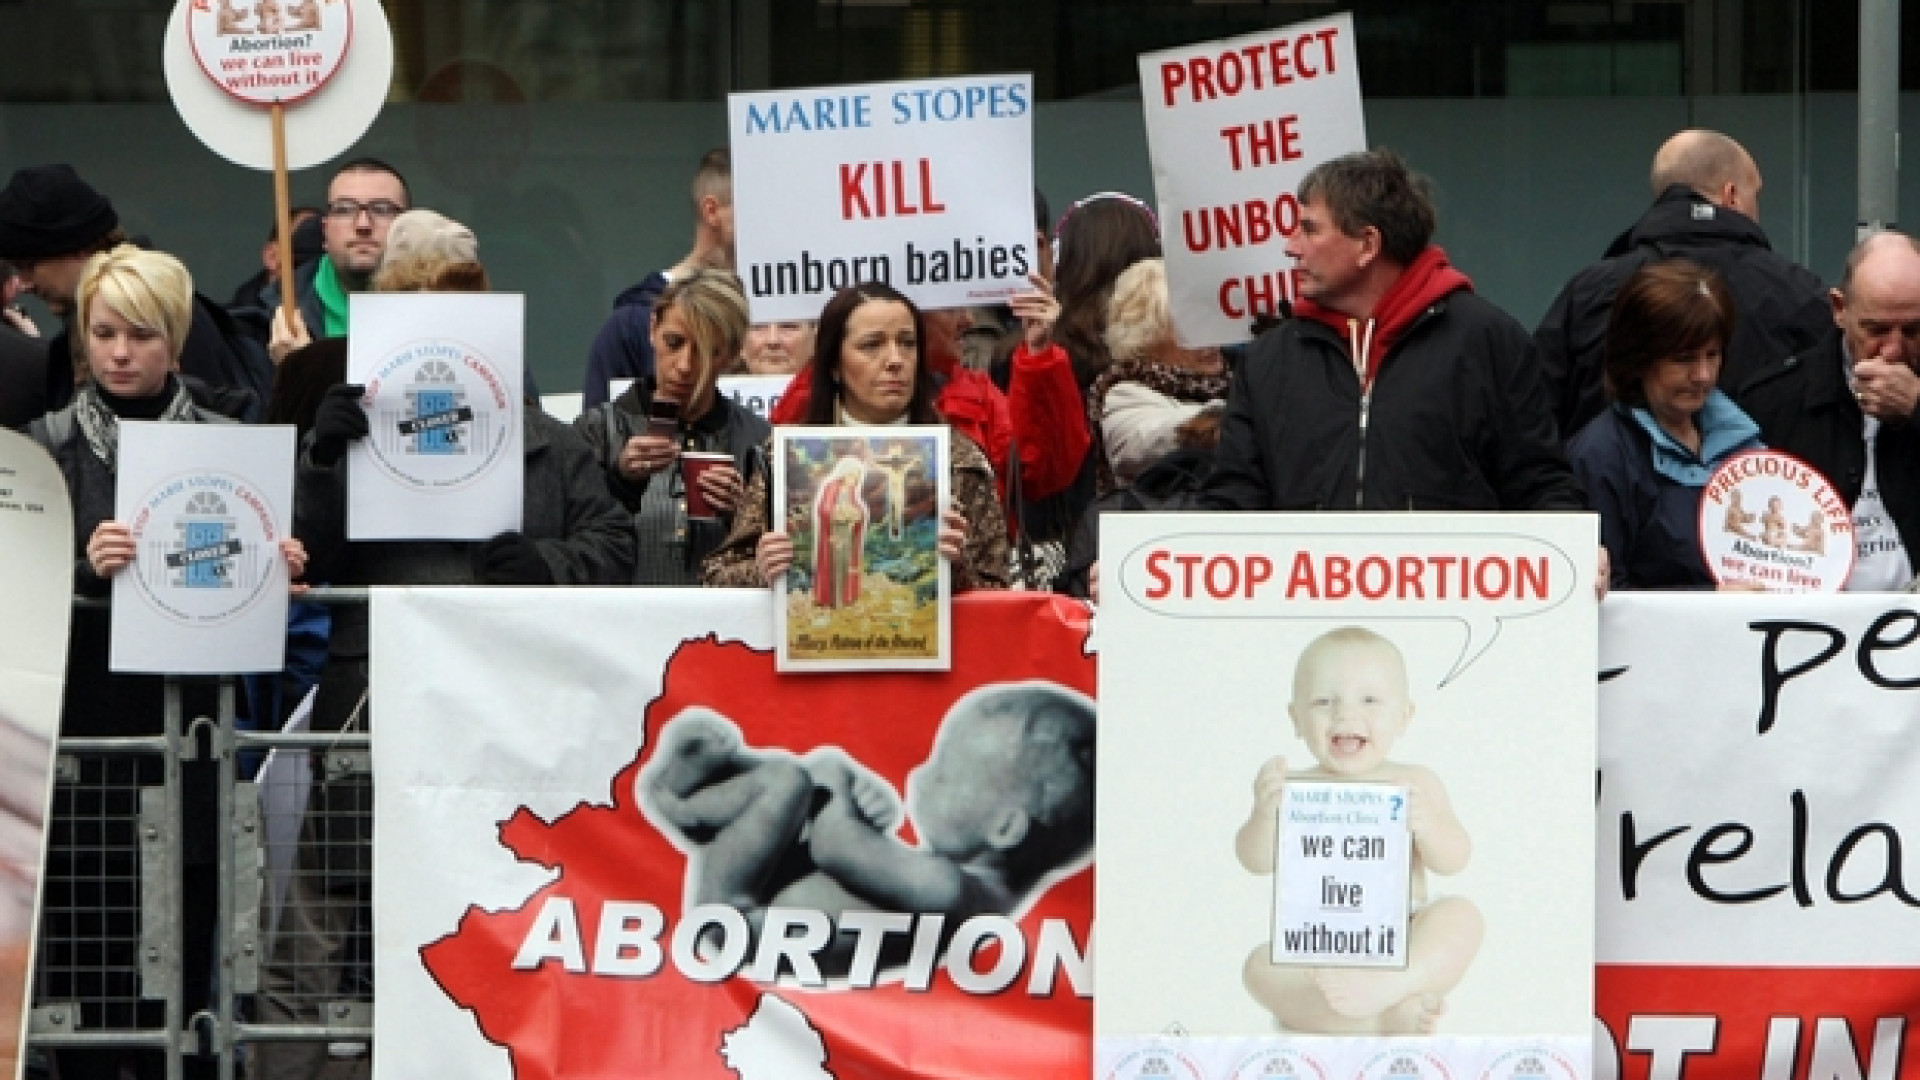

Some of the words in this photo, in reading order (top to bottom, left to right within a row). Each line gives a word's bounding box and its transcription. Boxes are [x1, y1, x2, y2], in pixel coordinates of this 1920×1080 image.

[220, 58, 248, 71] we
[253, 56, 285, 68] can
[290, 52, 322, 66] live
[229, 34, 313, 52] Abortion?
[1160, 27, 1338, 108] PROTECT
[225, 71, 298, 87] without
[306, 70, 320, 84] it
[745, 95, 871, 136] MARIE
[891, 82, 1028, 125] STOPES
[1219, 114, 1304, 171] THE
[839, 157, 946, 220] KILL
[1182, 192, 1299, 253] UNBO
[750, 251, 890, 298] unborn
[906, 235, 1029, 285] babies
[1217, 269, 1301, 320] CHI
[1709, 457, 1810, 504] PRECIOUS
[1812, 486, 1853, 533] LIFE
[1144, 549, 1274, 601] STOP
[1284, 550, 1550, 601] ABORTION
[1722, 556, 1744, 569] we
[1750, 560, 1784, 579] can
[1787, 568, 1822, 588] live
[1732, 539, 1815, 569] Abortion?
[1301, 835, 1334, 858] we
[1341, 835, 1385, 860] can
[1618, 789, 1920, 909] rela
[1321, 875, 1363, 907] live
[510, 896, 1094, 998] ABORTION
[1284, 922, 1372, 954] without
[1378, 925, 1395, 956] it
